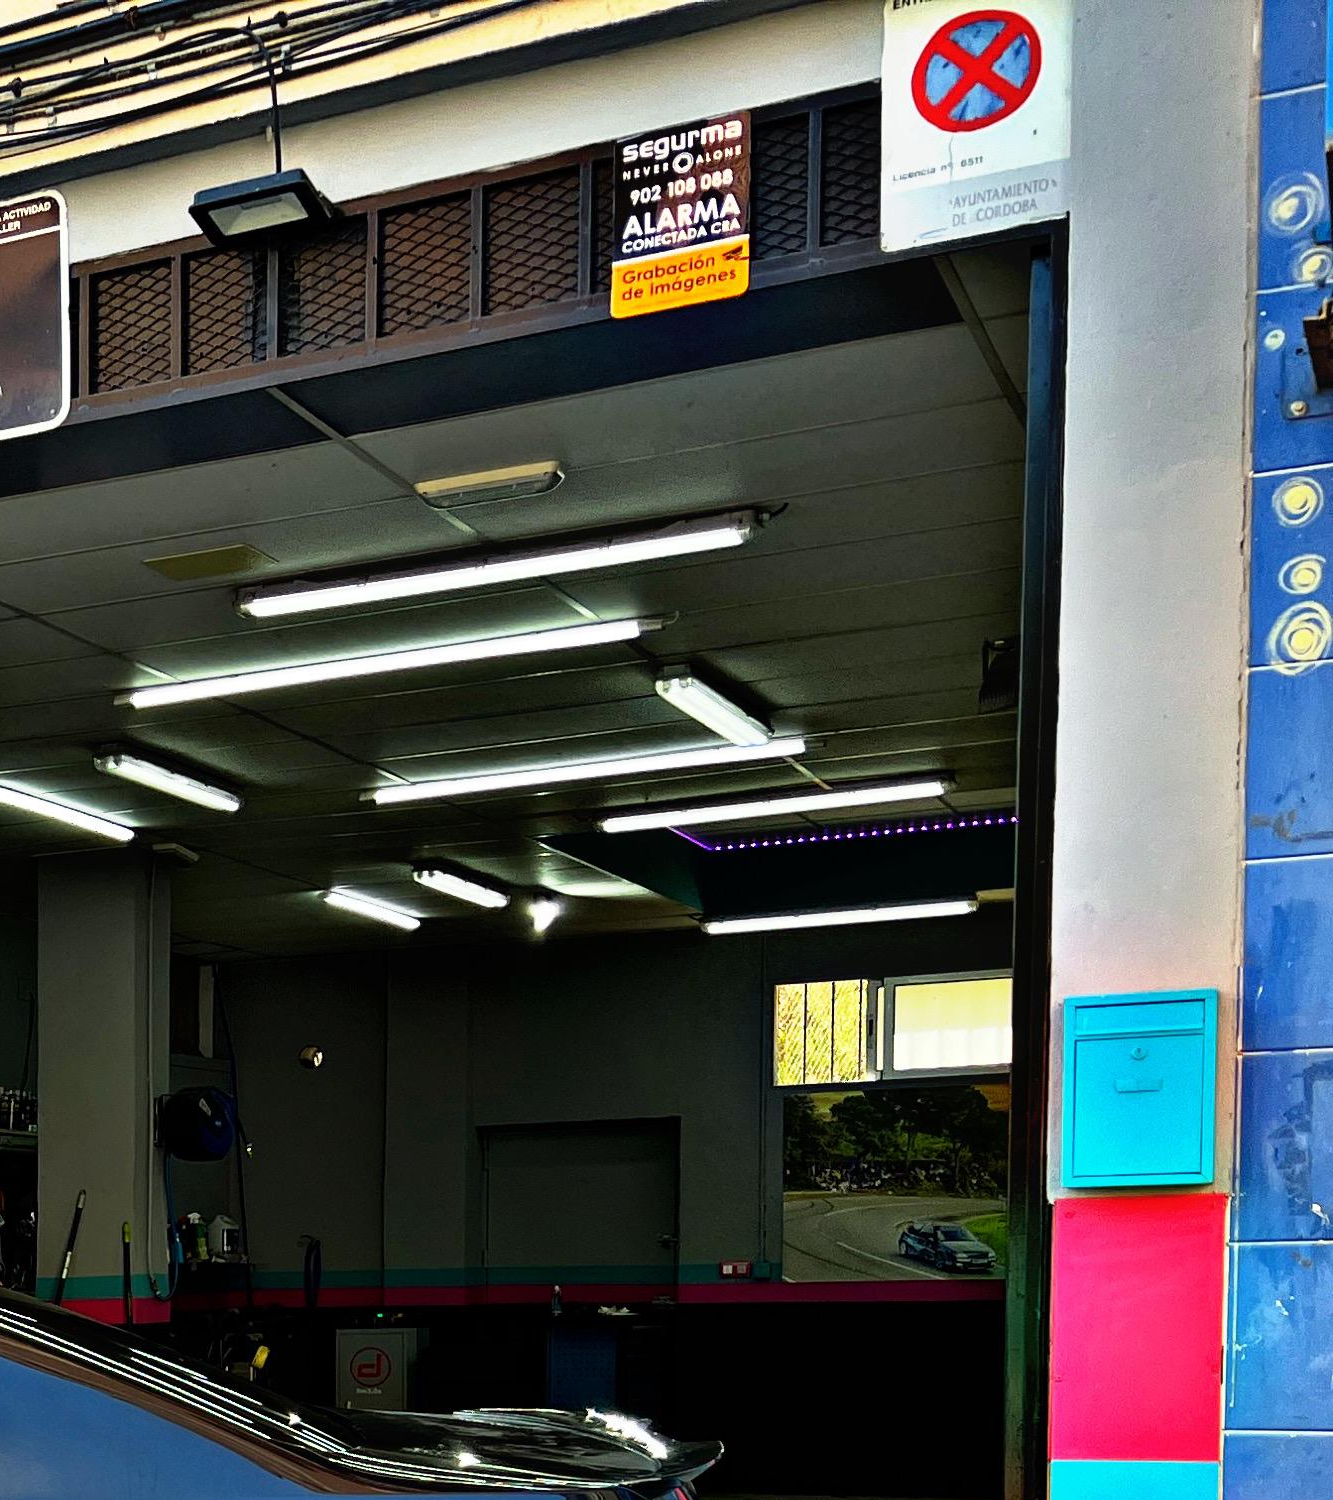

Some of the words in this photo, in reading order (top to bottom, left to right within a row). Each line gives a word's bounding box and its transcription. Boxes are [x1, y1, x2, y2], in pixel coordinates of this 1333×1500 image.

[622, 119, 743, 163] segurma
[622, 162, 669, 181] NEVER
[695, 144, 742, 165] ALONE
[630, 185, 662, 206] 902
[952, 177, 1049, 209] AYUNTAMIENTO
[2, 201, 51, 221] ACTIVIDAD
[622, 193, 741, 240] ALARMA
[952, 212, 967, 227] DE
[621, 226, 707, 254] CONECTADA
[622, 253, 716, 285] Grabación
[622, 286, 644, 301] de
[649, 267, 737, 297] imágenes
